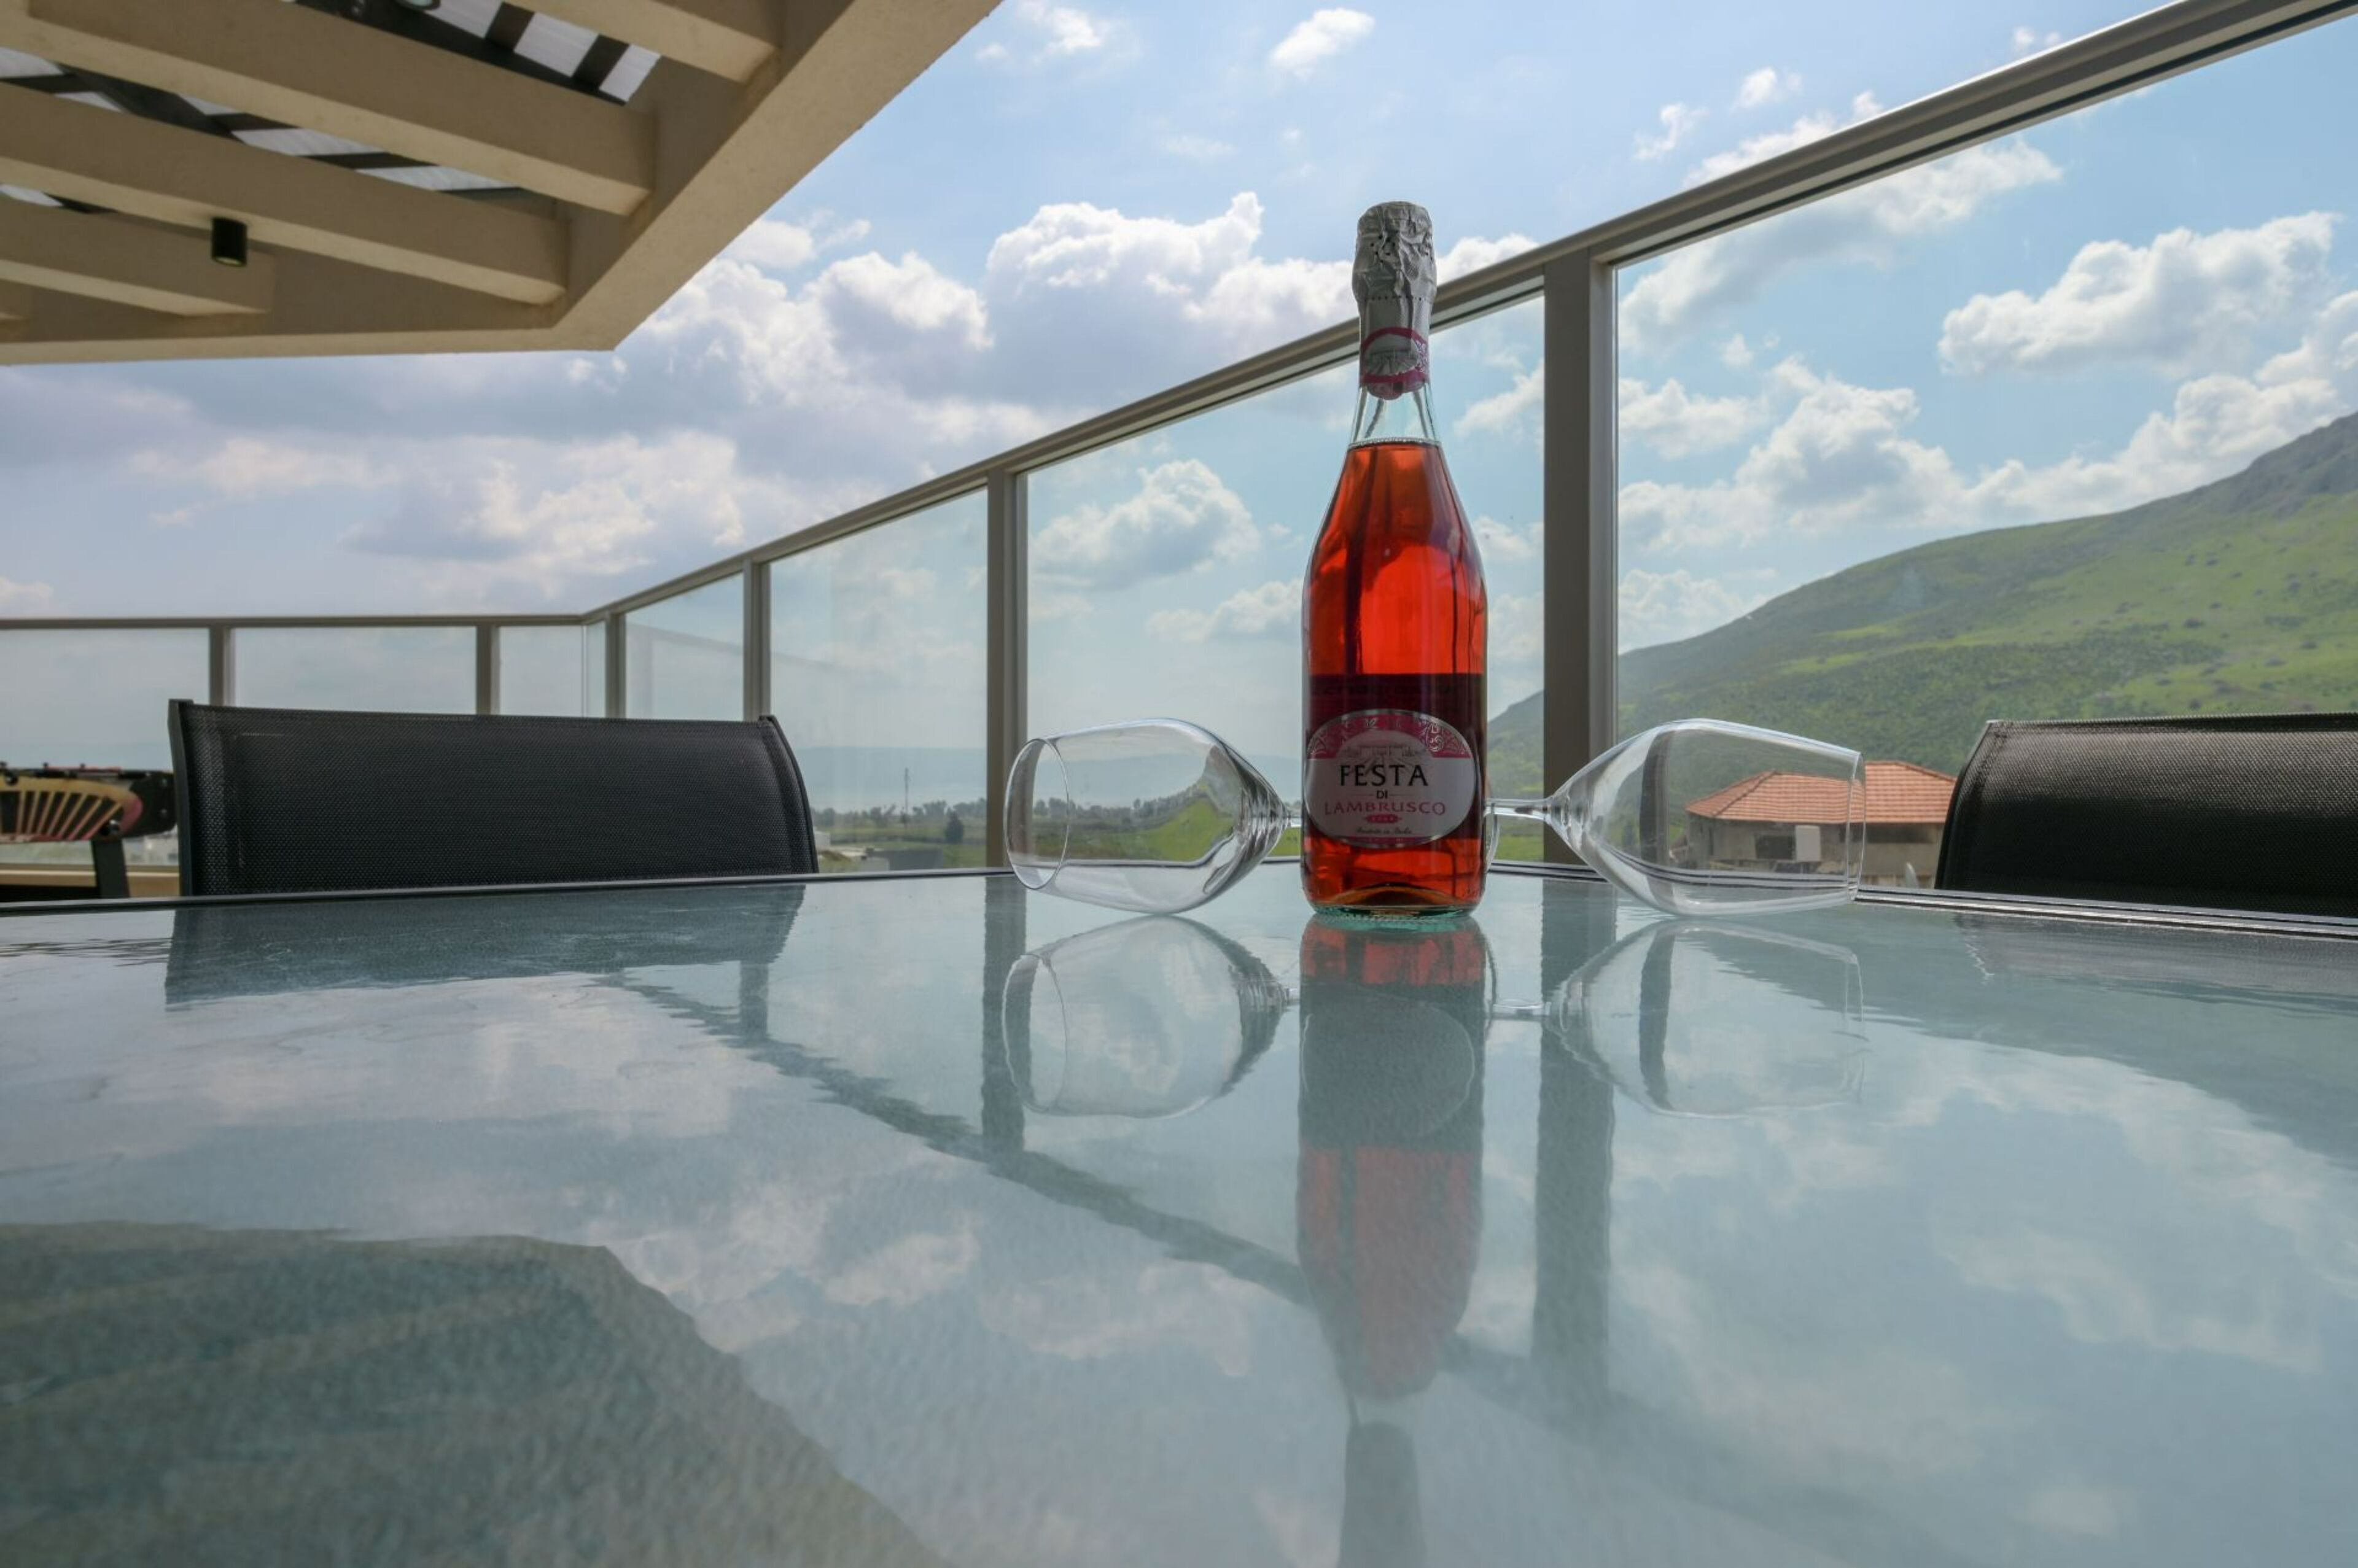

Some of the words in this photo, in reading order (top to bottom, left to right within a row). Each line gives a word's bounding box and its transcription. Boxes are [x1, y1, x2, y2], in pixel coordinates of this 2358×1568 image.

[1340, 765, 1428, 786] FESTA
[1376, 790, 1388, 799] DI
[1325, 801, 1446, 815] LAMBRUSCO
